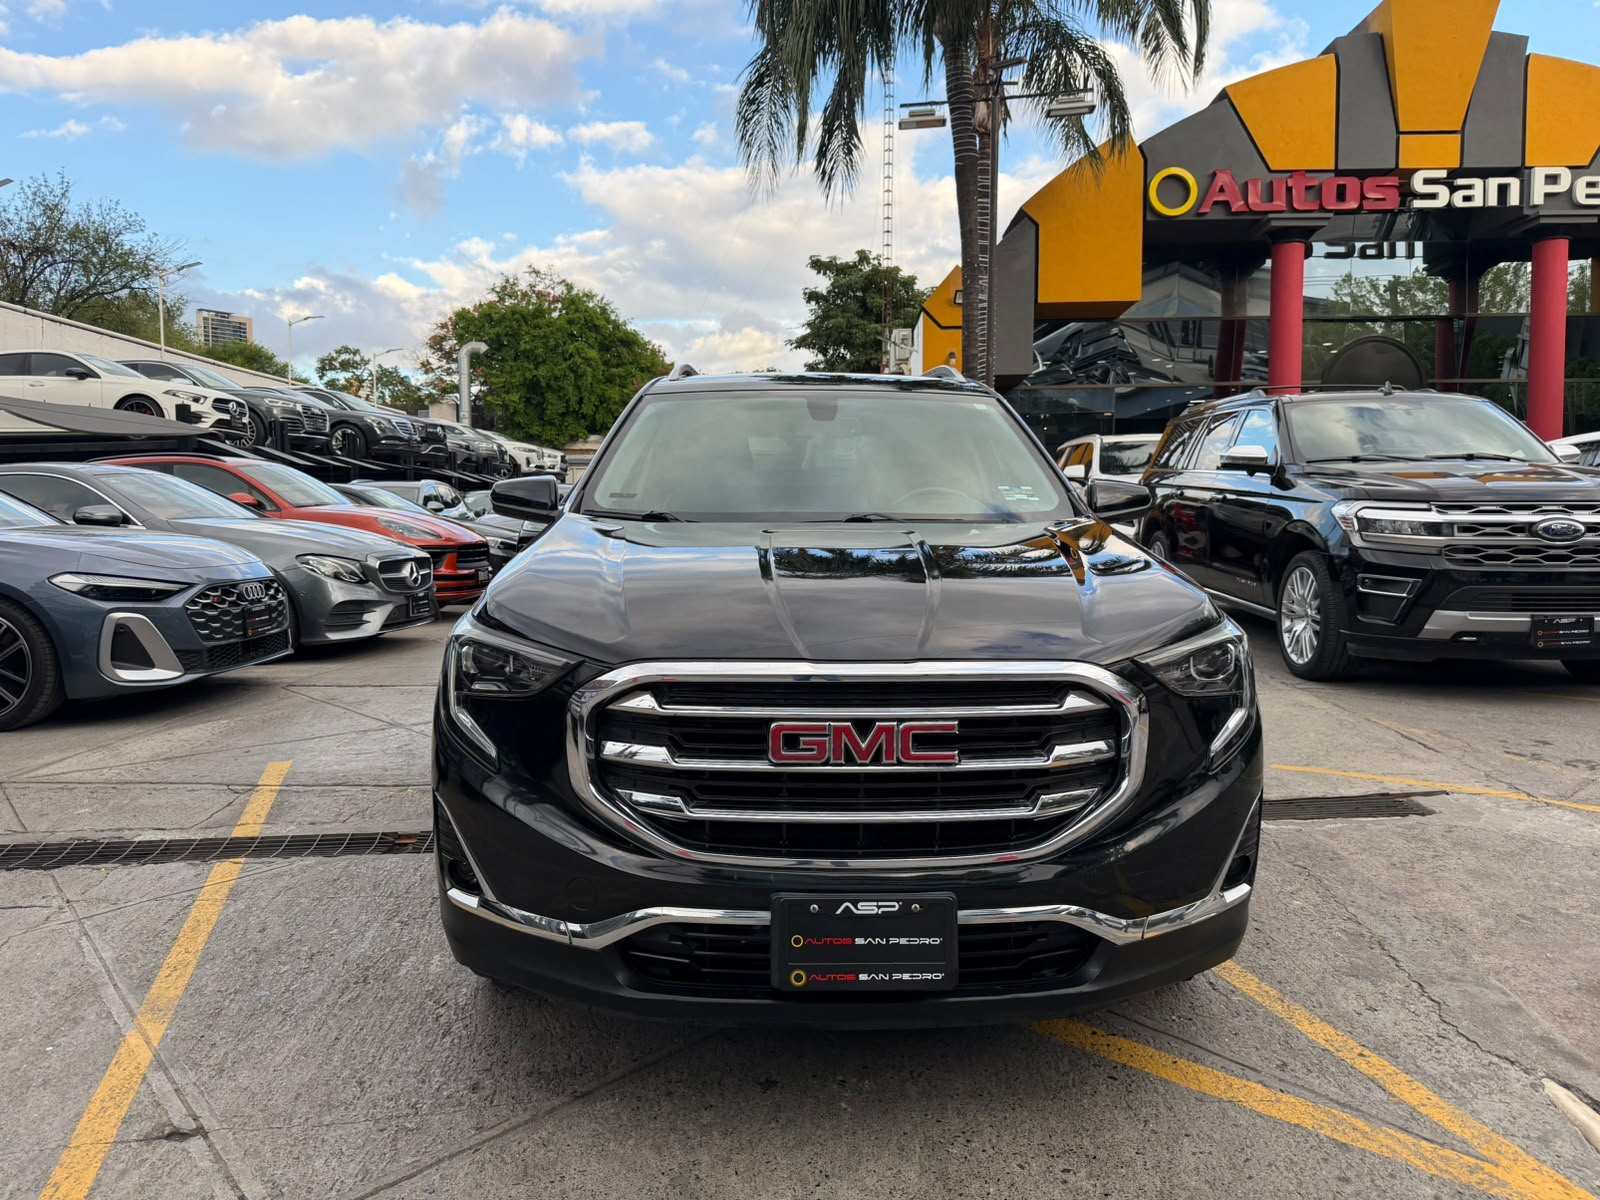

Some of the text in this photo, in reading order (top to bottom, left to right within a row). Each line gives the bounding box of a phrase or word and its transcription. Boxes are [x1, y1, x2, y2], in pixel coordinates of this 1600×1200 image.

[1198, 169, 1400, 213] Autos
[1411, 169, 1520, 208] San
[768, 721, 959, 764] GMC
[835, 901, 902, 914] ASP
[804, 937, 943, 945] AUTOS SAN PEDRO
[809, 972, 945, 981] AUTOS SAN PEDRO
